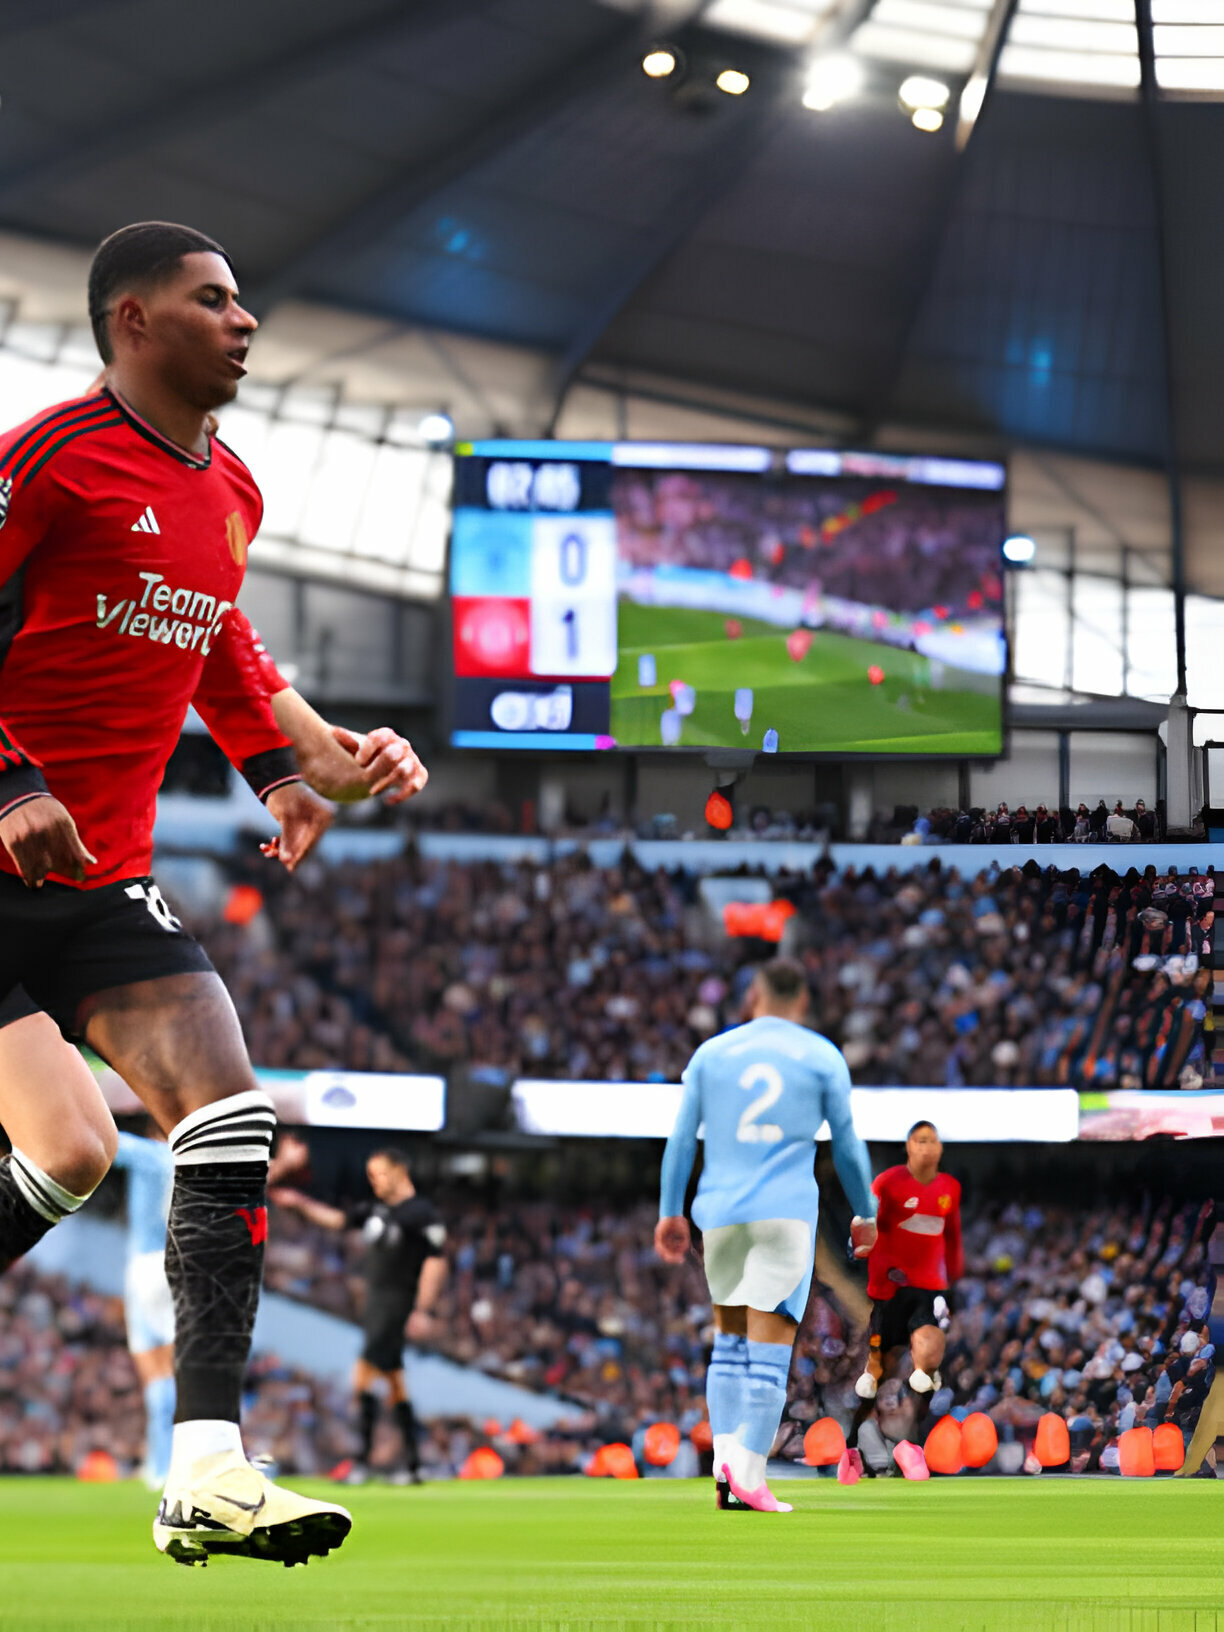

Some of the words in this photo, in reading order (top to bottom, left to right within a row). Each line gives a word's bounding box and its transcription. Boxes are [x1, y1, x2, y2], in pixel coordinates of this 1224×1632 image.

[559, 532, 589, 588] 0
[138, 571, 217, 623] Team
[562, 608, 577, 661] 1
[736, 1062, 784, 1144] 2
